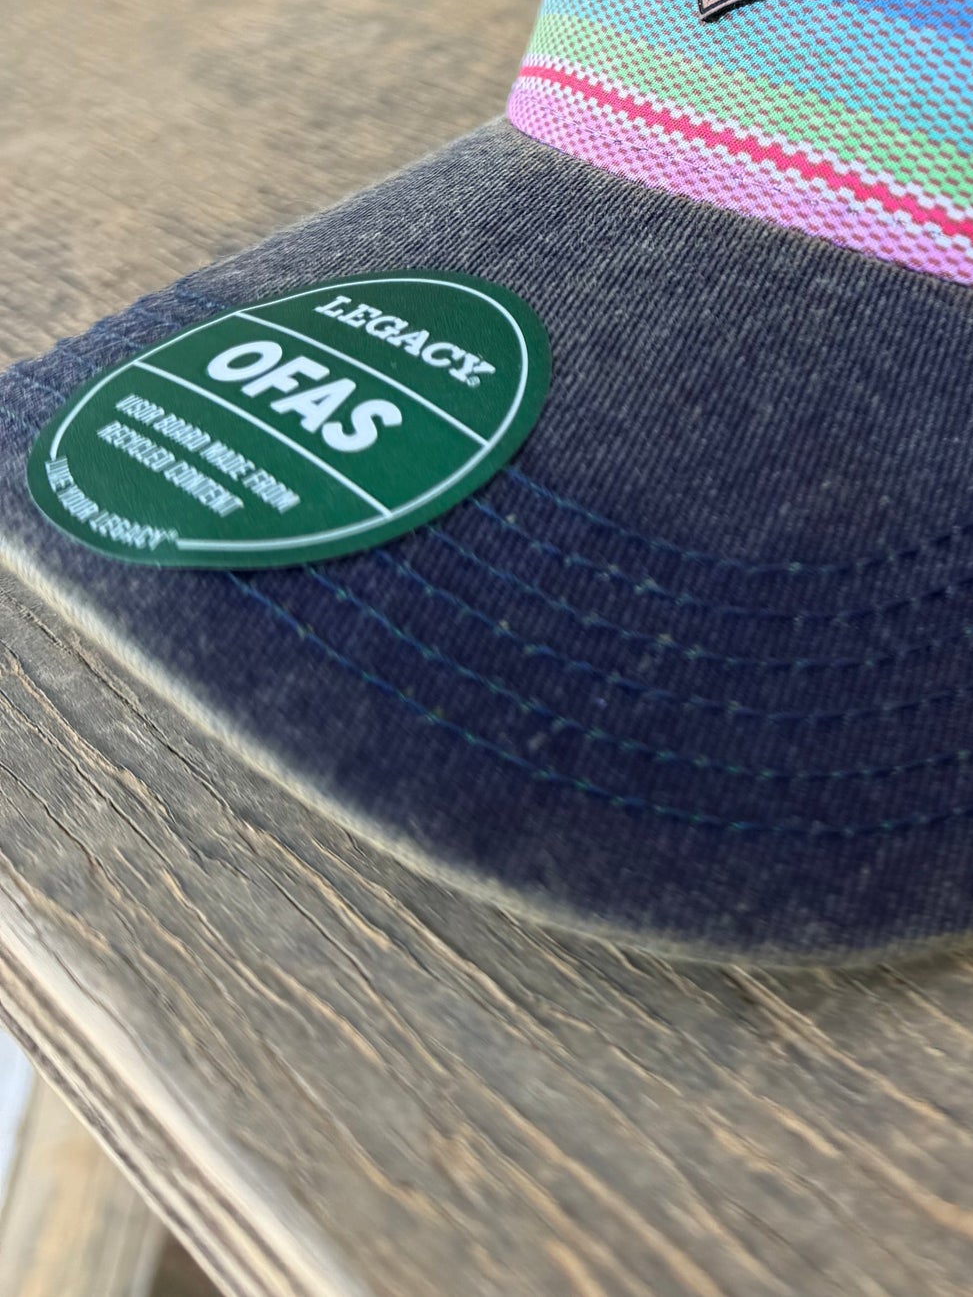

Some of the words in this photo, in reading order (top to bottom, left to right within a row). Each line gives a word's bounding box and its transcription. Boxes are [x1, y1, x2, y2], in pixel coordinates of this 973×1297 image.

[206, 340, 403, 452] OFAS
[96, 421, 175, 472] RECYCLED
[164, 461, 244, 518] CONTENT
[115, 393, 165, 426] VISOR
[153, 413, 211, 452] BOARD
[200, 441, 256, 481] MADE
[242, 469, 300, 514] FROM
